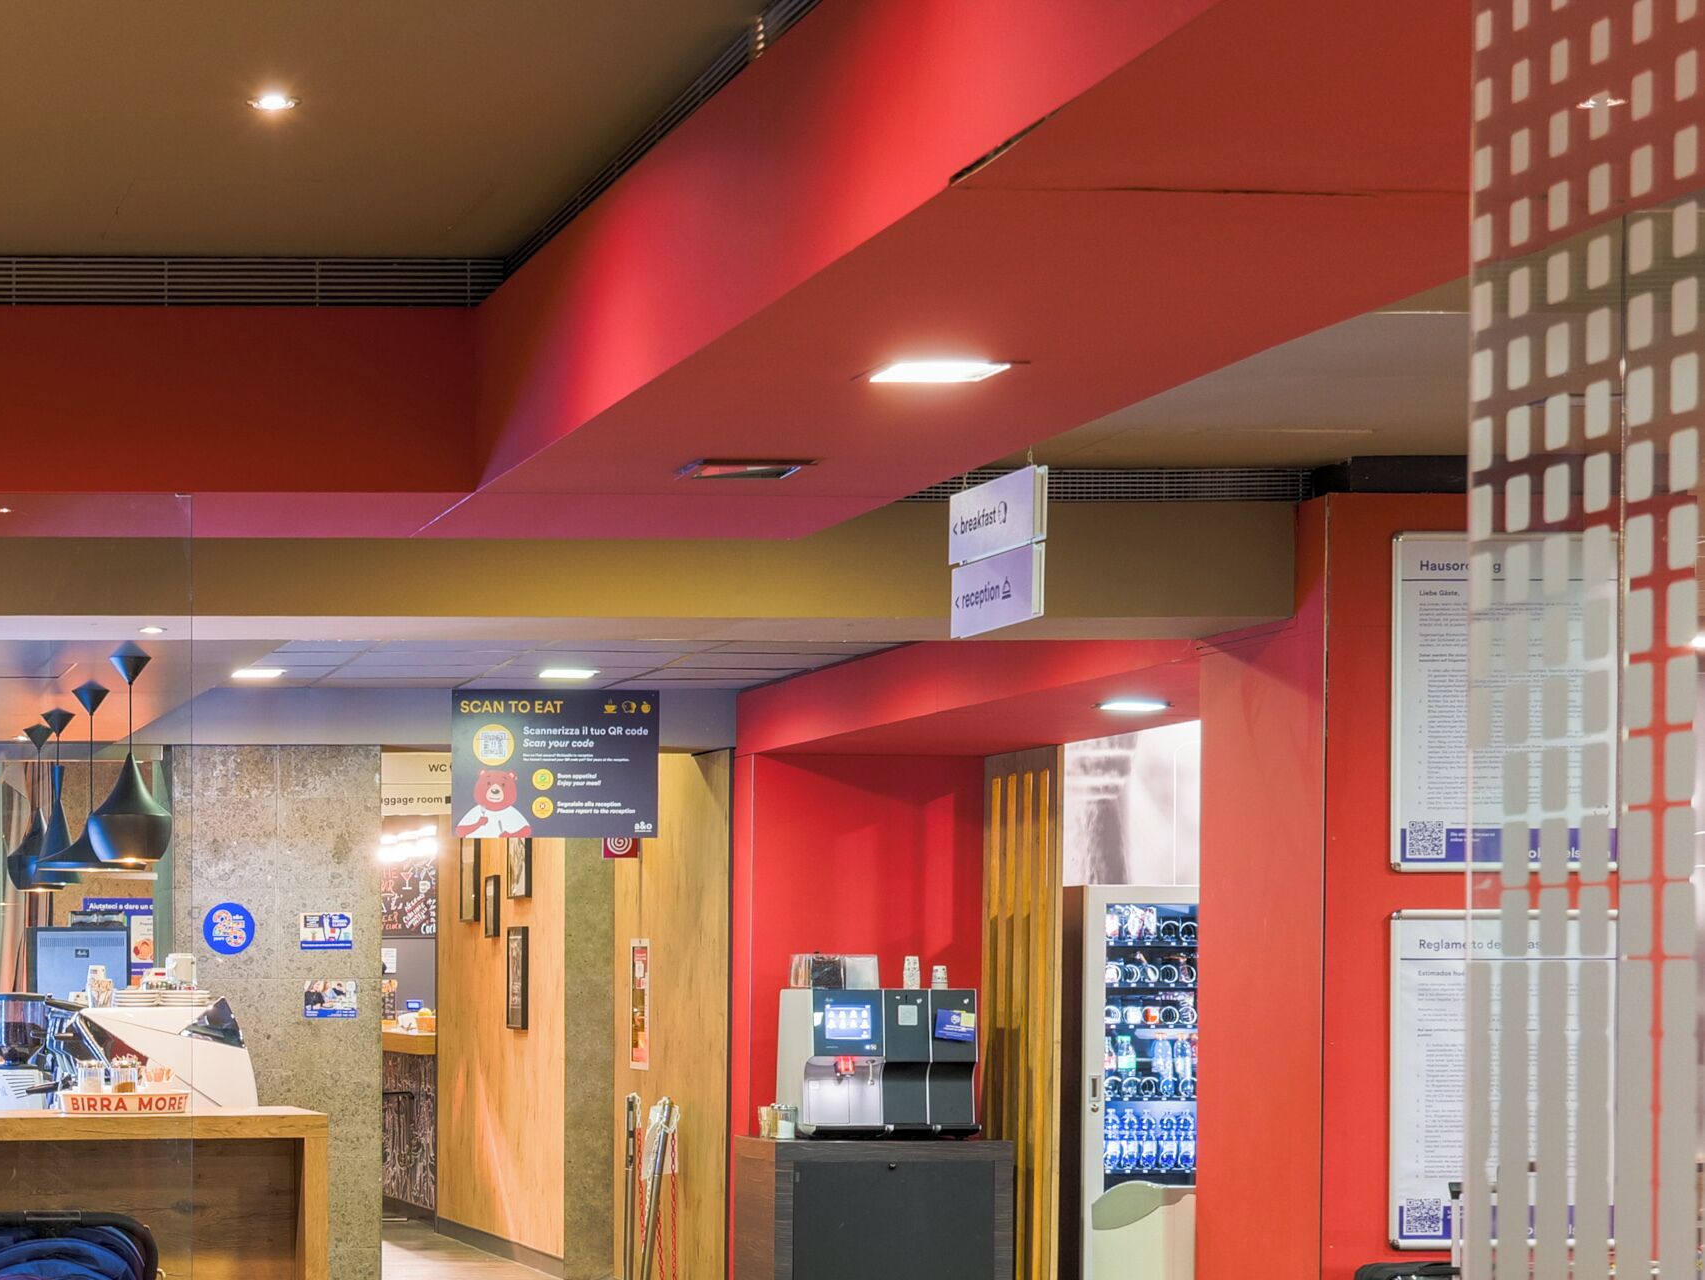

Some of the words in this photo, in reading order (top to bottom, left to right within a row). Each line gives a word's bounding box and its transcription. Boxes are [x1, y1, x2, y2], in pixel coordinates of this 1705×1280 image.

[960, 507, 997, 535] breakfast
[1420, 560, 1501, 573] Hausorg
[961, 581, 1001, 609] reception
[460, 700, 505, 714] SCAN
[508, 700, 531, 714] TO
[534, 700, 564, 714] EAT
[523, 726, 580, 736] Scannerizza
[582, 726, 588, 735] il
[590, 727, 606, 735] tuo
[608, 726, 623, 735] QR
[625, 726, 649, 735] code
[523, 738, 546, 748] Scan
[548, 739, 570, 749] your
[571, 738, 594, 748] code
[428, 763, 447, 772] WC
[380, 797, 414, 805] ggage
[634, 821, 653, 830] a&o
[88, 902, 117, 910] Aiutateci
[1418, 939, 1484, 951] Reglameto
[71, 1097, 128, 1111] BIRRA
